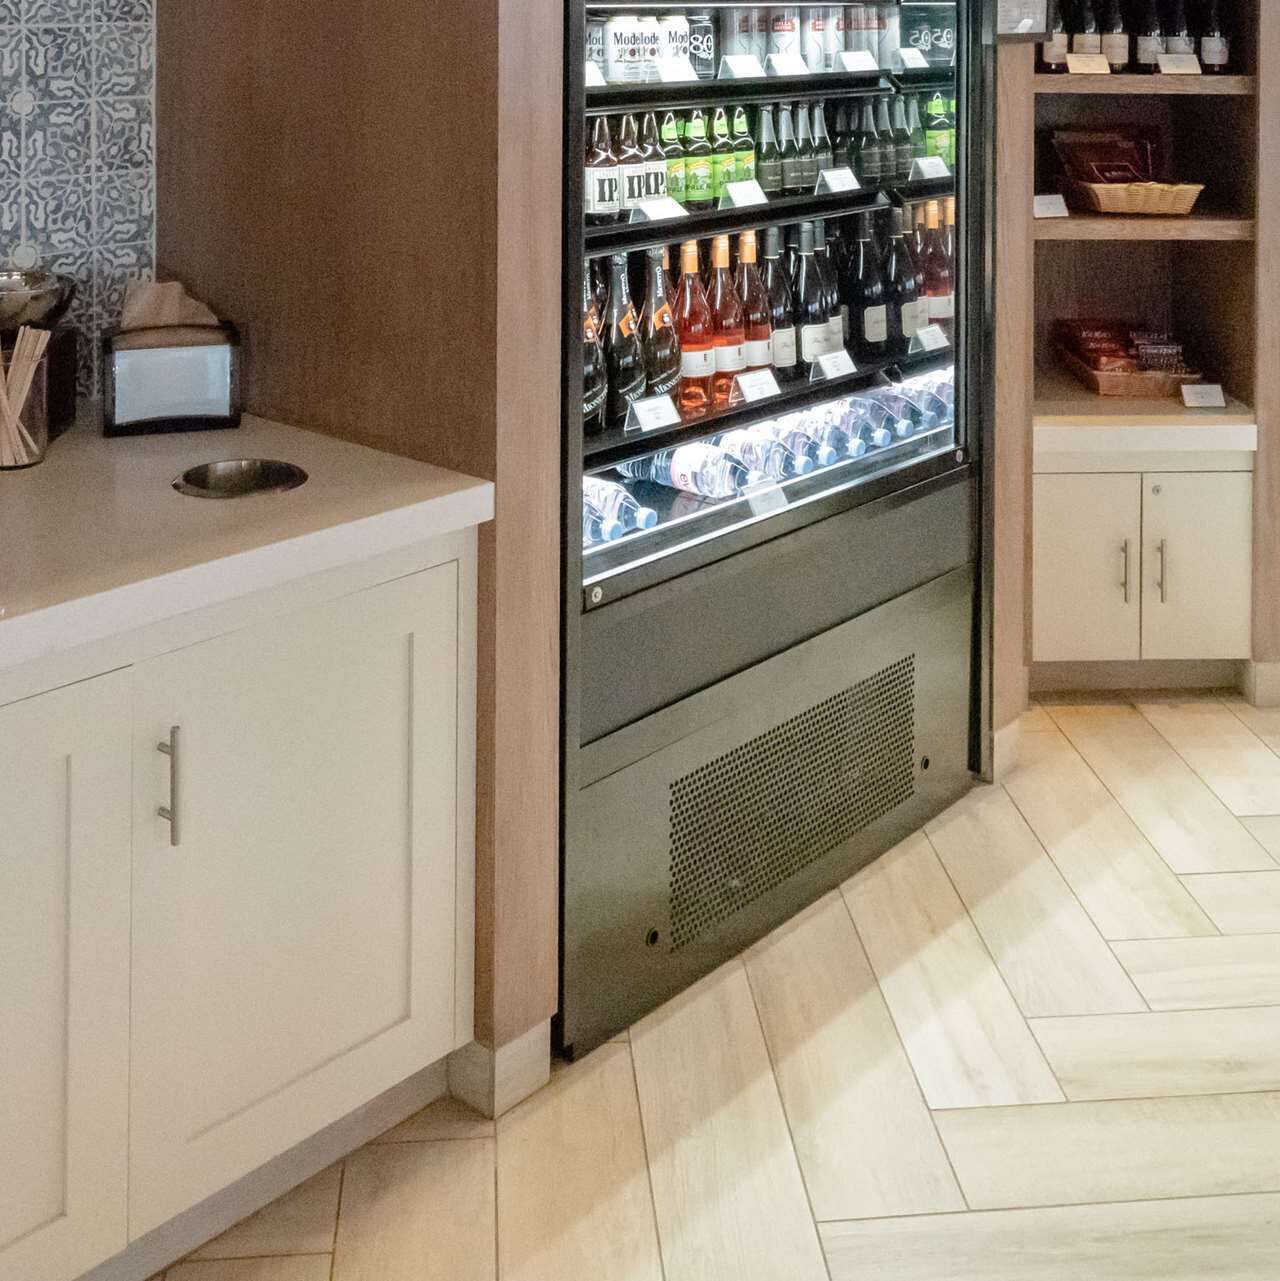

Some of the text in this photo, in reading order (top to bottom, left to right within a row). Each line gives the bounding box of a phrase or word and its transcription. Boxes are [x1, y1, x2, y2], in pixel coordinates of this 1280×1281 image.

[690, 34, 714, 55] 80
[596, 178, 619, 202] IP
[626, 175, 644, 199] IP
[644, 172, 666, 195] IP
